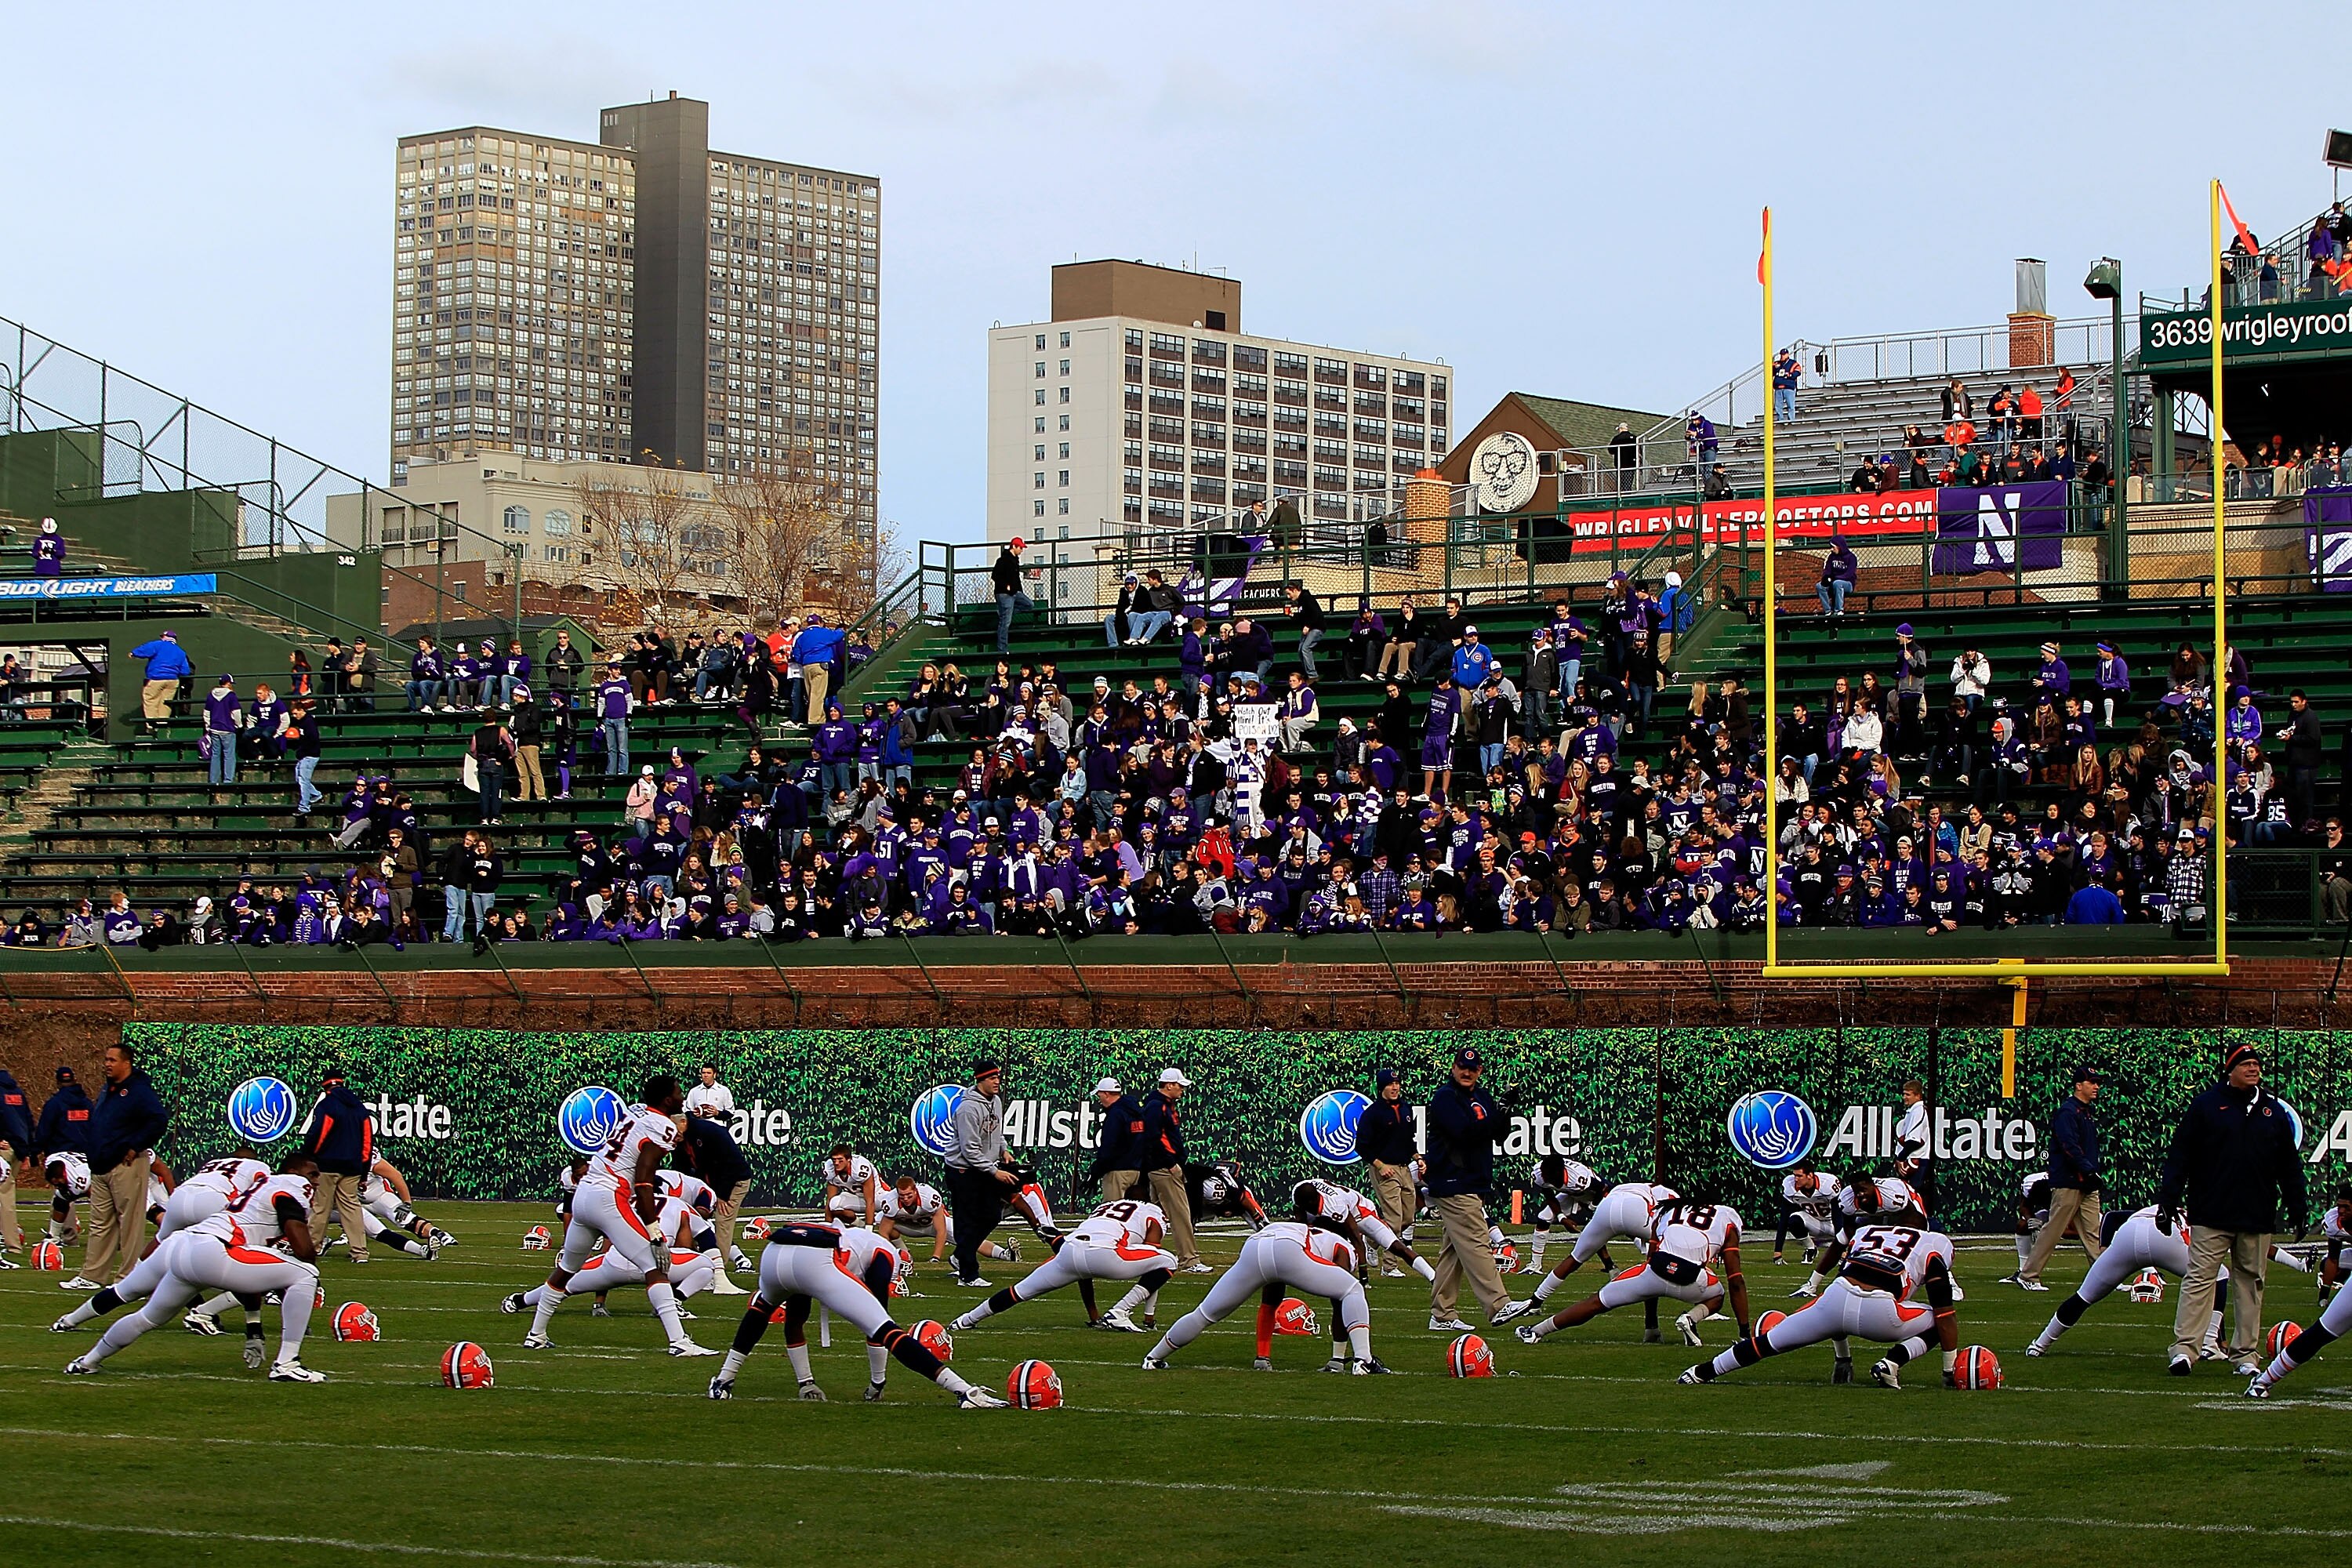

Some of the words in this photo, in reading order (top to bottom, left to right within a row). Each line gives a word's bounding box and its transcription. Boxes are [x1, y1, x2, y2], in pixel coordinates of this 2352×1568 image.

[1574, 500, 1933, 542] WRIGLEYVLLEROOFTOPS.COM
[338, 556, 356, 565] 342
[51, 582, 112, 594] LIGHT
[113, 579, 175, 592] BLEACHERS
[1240, 588, 1280, 600] LEACHERS
[1239, 725, 1266, 735] POISON
[2267, 805, 2285, 822] 85
[880, 841, 891, 858] 51
[1751, 850, 1765, 872] N
[1003, 1099, 1106, 1149] Allst
[1823, 1105, 2036, 1160] Alltate
[858, 1164, 869, 1178] 83
[75, 1176, 87, 1191] 72
[931, 1194, 941, 1209] 49
[1892, 1195, 1906, 1208] 11
[1668, 1205, 1718, 1230] 18
[1858, 1228, 1921, 1260] 53
